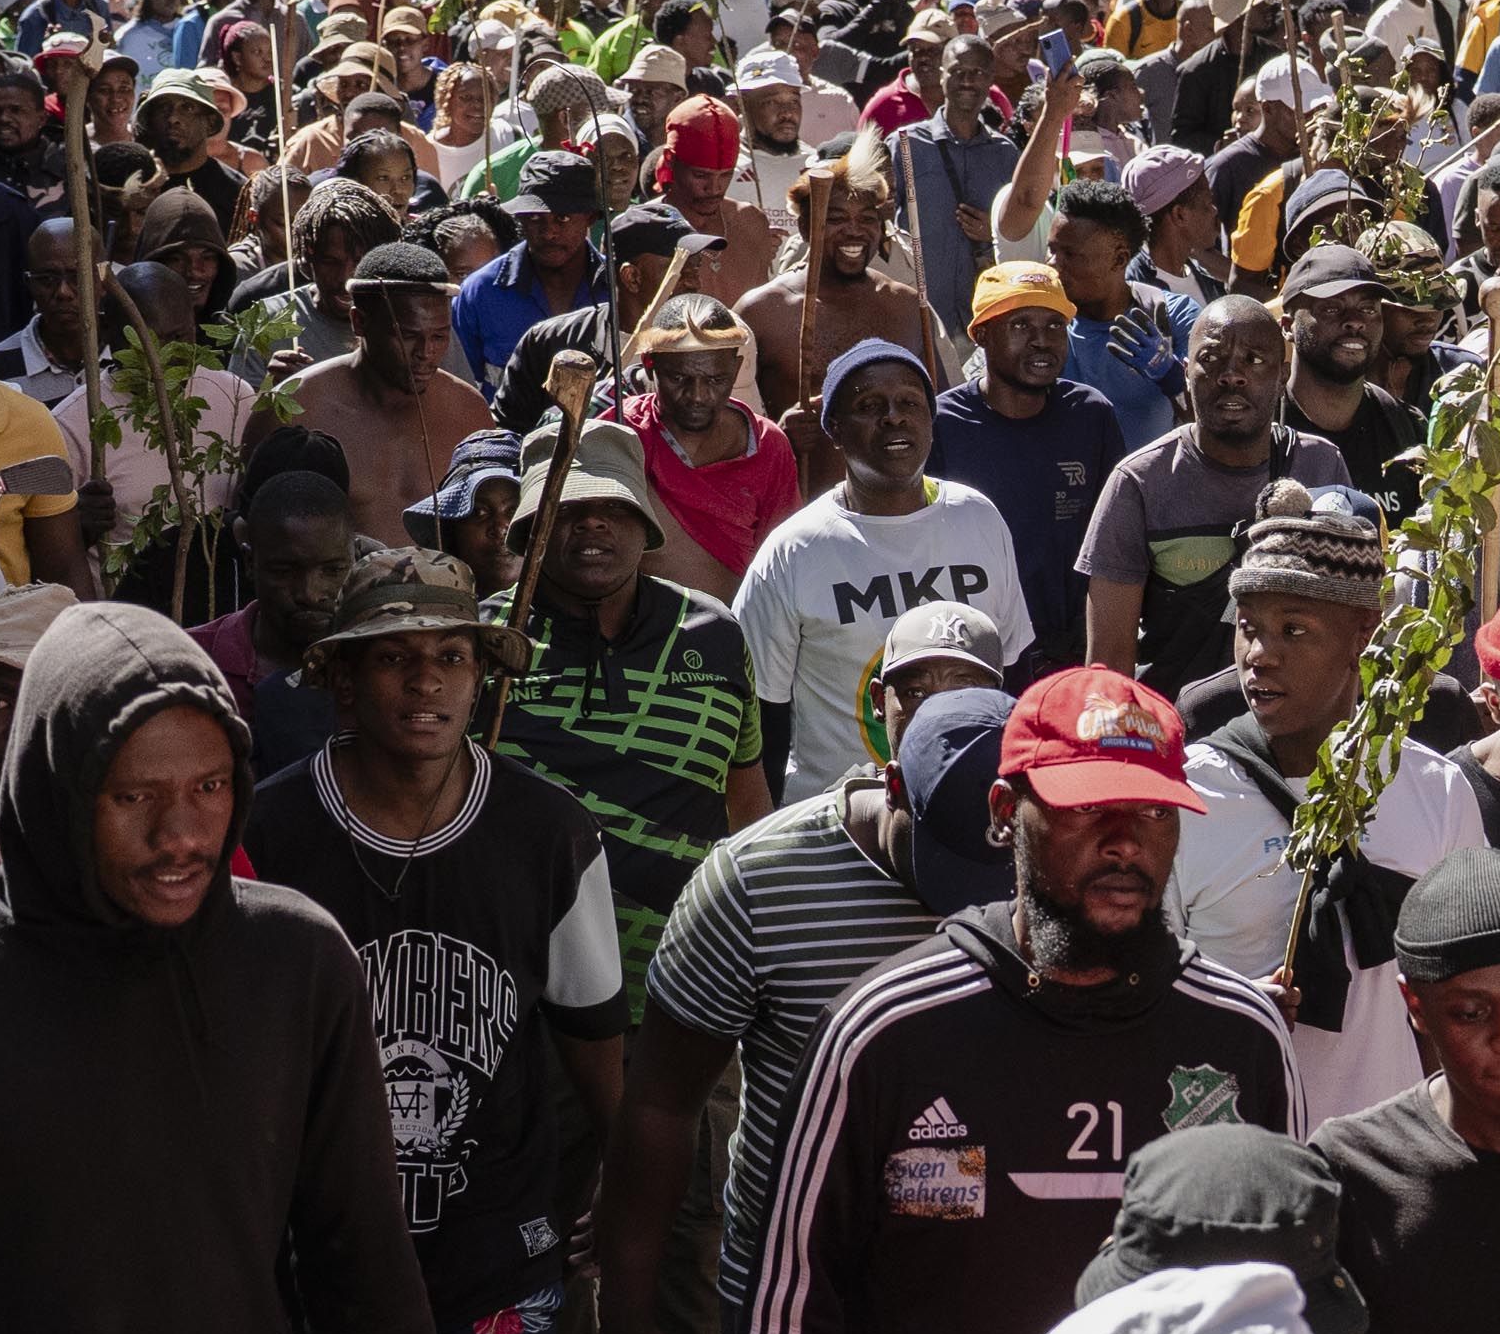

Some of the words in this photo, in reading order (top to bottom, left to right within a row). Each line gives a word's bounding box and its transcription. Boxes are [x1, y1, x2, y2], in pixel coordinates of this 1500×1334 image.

[834, 565, 989, 625] MKP
[1101, 738, 1130, 748] ORDER
[386, 1041, 431, 1063] ONLY
[1180, 1079, 1205, 1106] FC
[908, 1124, 968, 1141] adidas
[1066, 1100, 1123, 1161] 21
